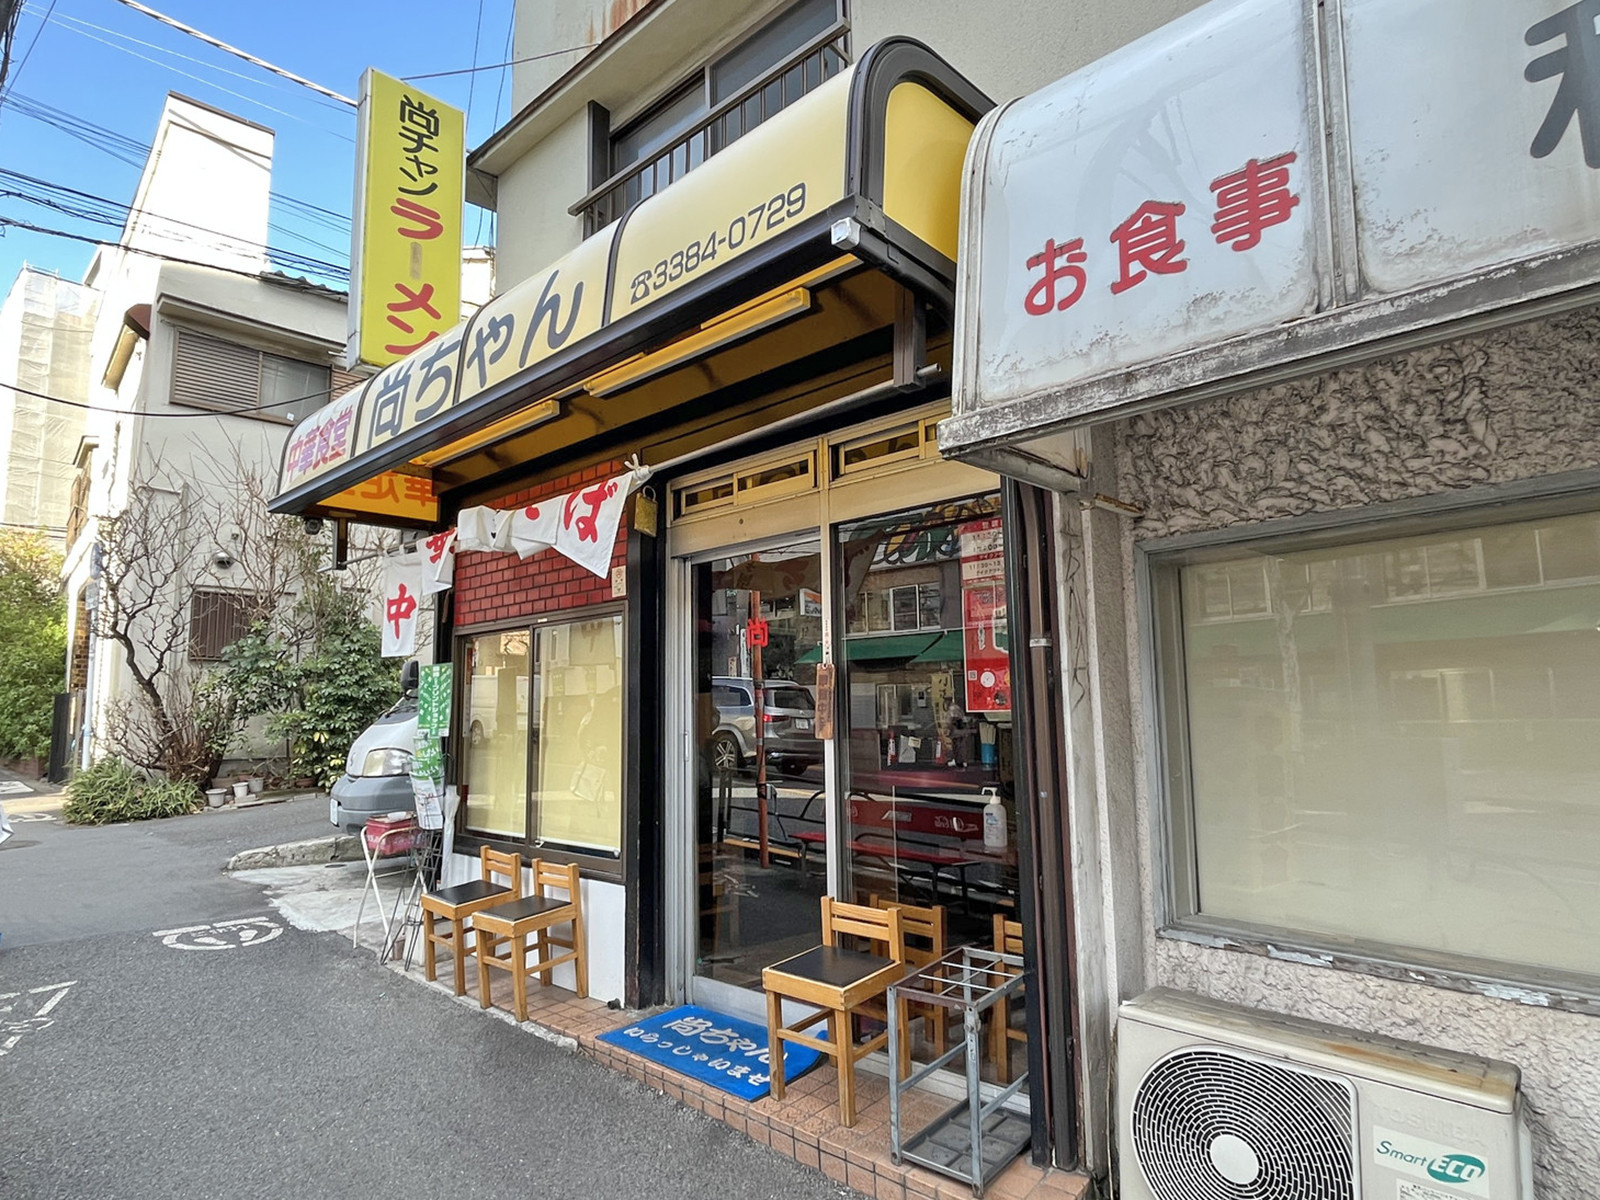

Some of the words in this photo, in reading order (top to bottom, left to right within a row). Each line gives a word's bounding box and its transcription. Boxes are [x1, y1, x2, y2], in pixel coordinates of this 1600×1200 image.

[1023, 151, 1300, 317] お食事
[367, 269, 584, 449] 尚ちゃん
[287, 405, 353, 483] 中華食堂
[623, 1027, 771, 1086] いらっしゃいませ
[1376, 1140, 1427, 1166] Smart
[1429, 1155, 1484, 1182] ECO
